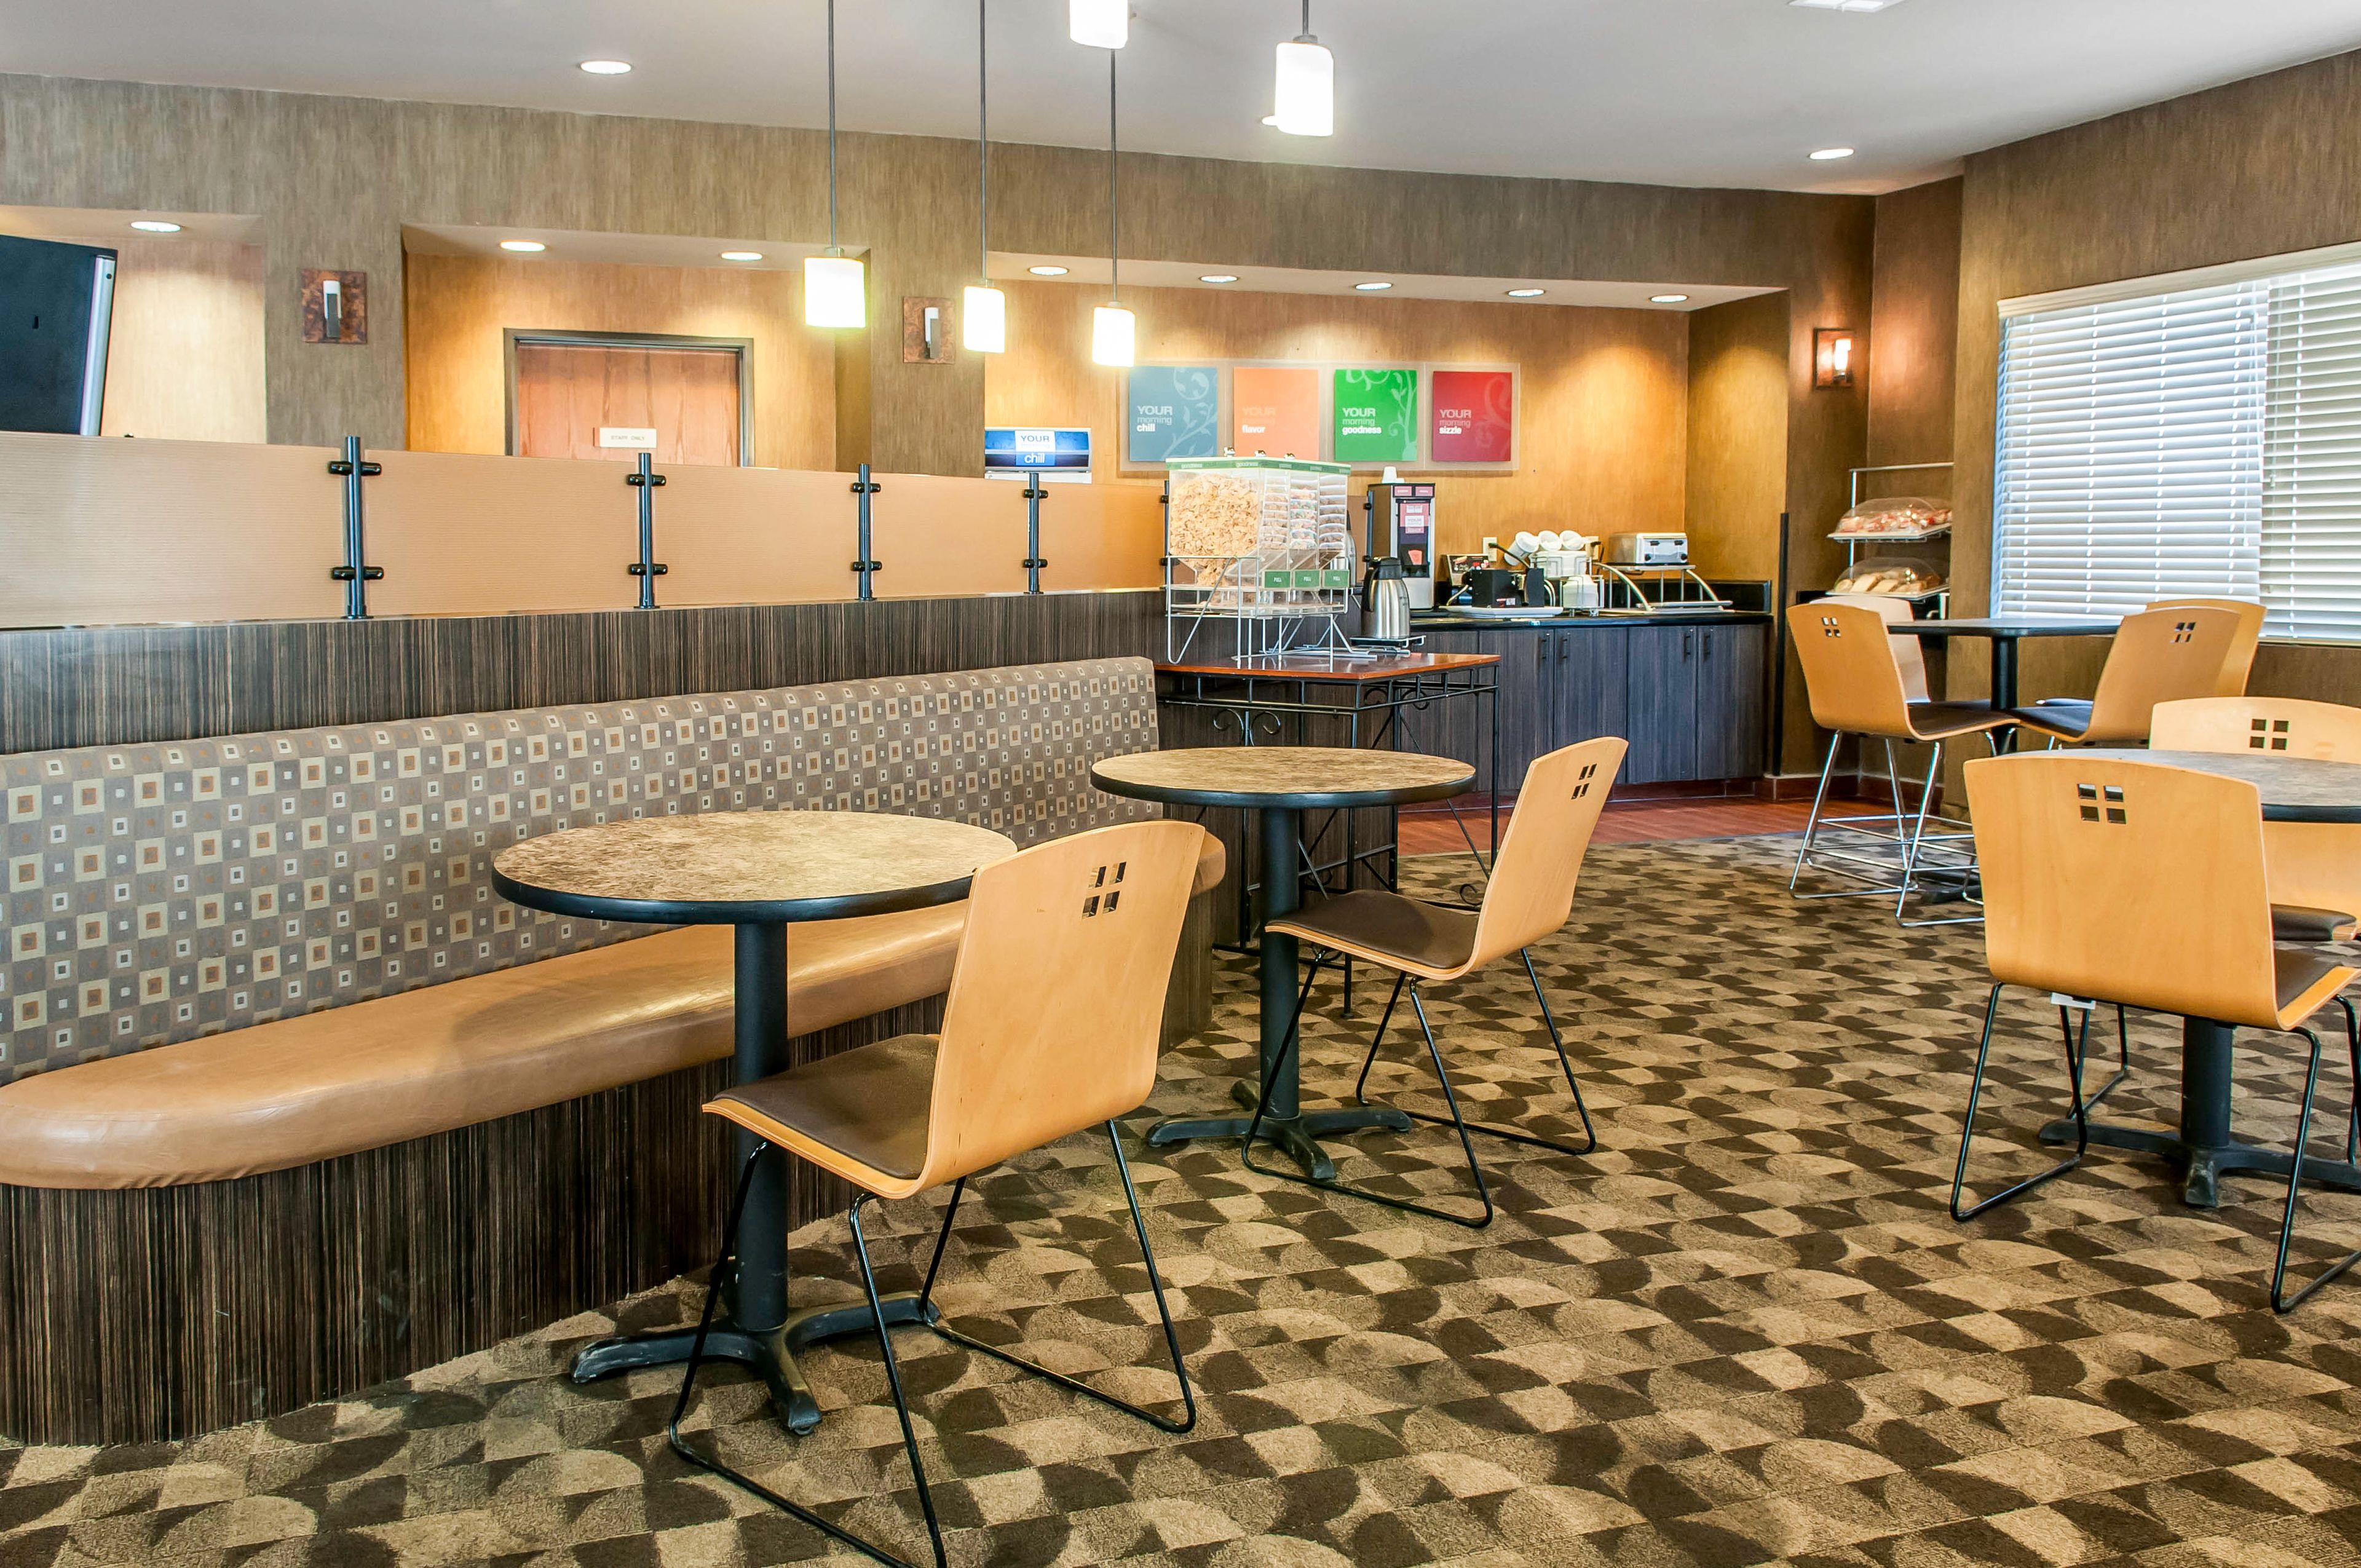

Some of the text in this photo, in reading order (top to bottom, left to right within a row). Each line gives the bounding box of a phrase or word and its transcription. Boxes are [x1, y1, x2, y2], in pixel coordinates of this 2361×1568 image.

[1137, 405, 1173, 415] YOUR
[1242, 406, 1276, 416] YOUR
[1342, 407, 1375, 417] YOUR
[1439, 409, 1471, 418] YOUR
[1137, 416, 1172, 426] morning
[1439, 419, 1471, 429] morning
[1136, 423, 1156, 432] chill
[1242, 424, 1265, 433] flavor
[1342, 426, 1382, 435] goodness
[1439, 426, 1462, 434] sizzle
[1024, 453, 1045, 463] chill
